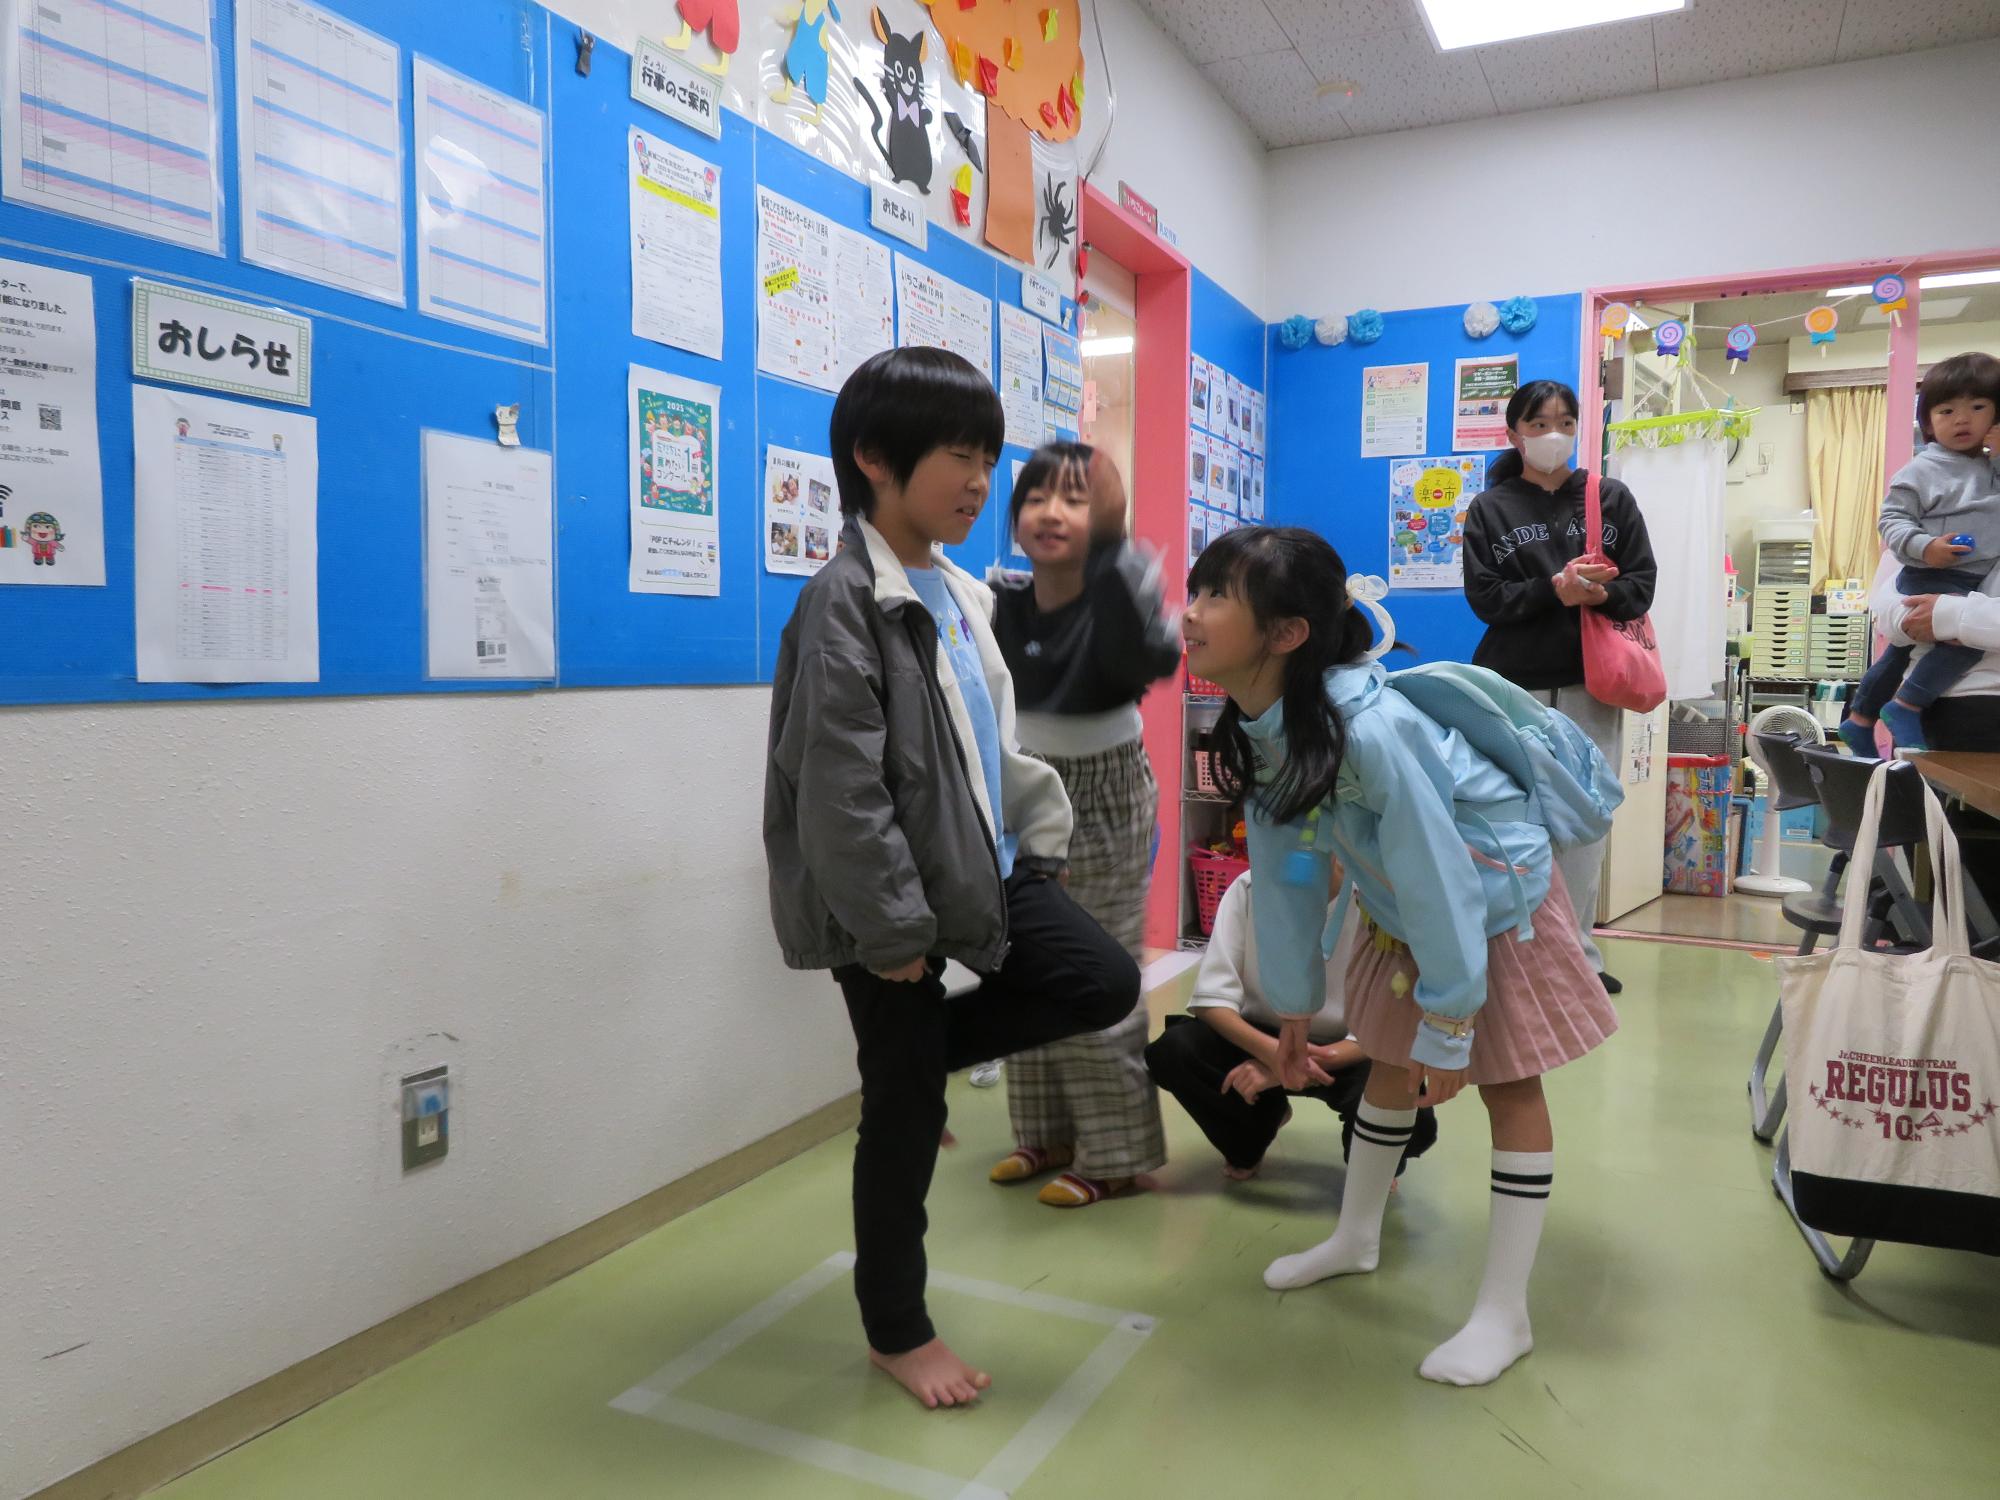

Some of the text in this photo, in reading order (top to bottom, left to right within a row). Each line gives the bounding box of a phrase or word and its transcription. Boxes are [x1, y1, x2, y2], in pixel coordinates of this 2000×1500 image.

[641, 66, 710, 117] 行事のご案内
[882, 196, 915, 227] おたより
[158, 319, 292, 377] おしらせ
[1825, 1060, 1971, 1112] REGULUS
[1925, 1059, 1957, 1070] TEAM
